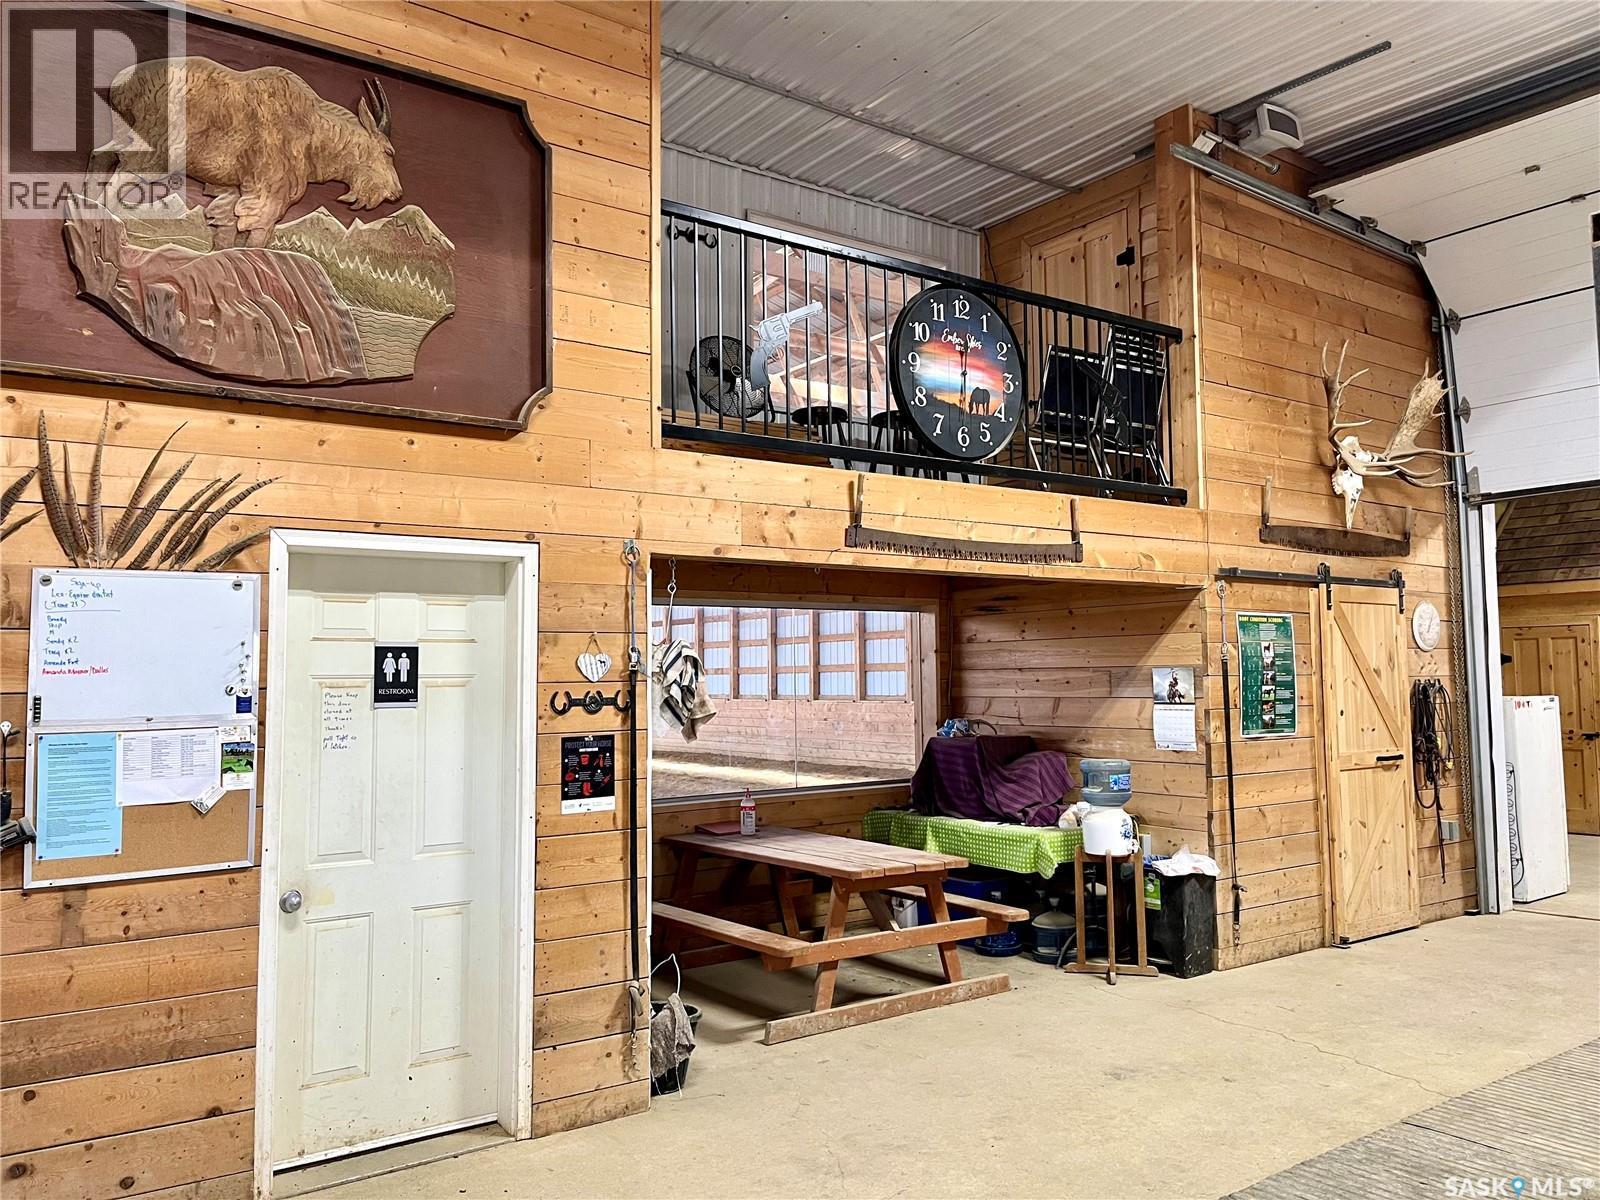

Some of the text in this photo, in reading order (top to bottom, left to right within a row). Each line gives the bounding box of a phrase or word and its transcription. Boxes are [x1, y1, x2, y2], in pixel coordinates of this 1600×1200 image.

[931, 302, 945, 322] 11
[953, 299, 971, 320] 12
[911, 322, 930, 342] 10
[980, 314, 988, 332] 1
[996, 342, 1008, 361] 2
[908, 352, 921, 372] 9
[1003, 373, 1014, 393] 3
[915, 386, 927, 407] 8
[994, 403, 1007, 422] 4
[932, 413, 945, 436] 7
[979, 422, 991, 442] 5
[957, 426, 970, 447] 6
